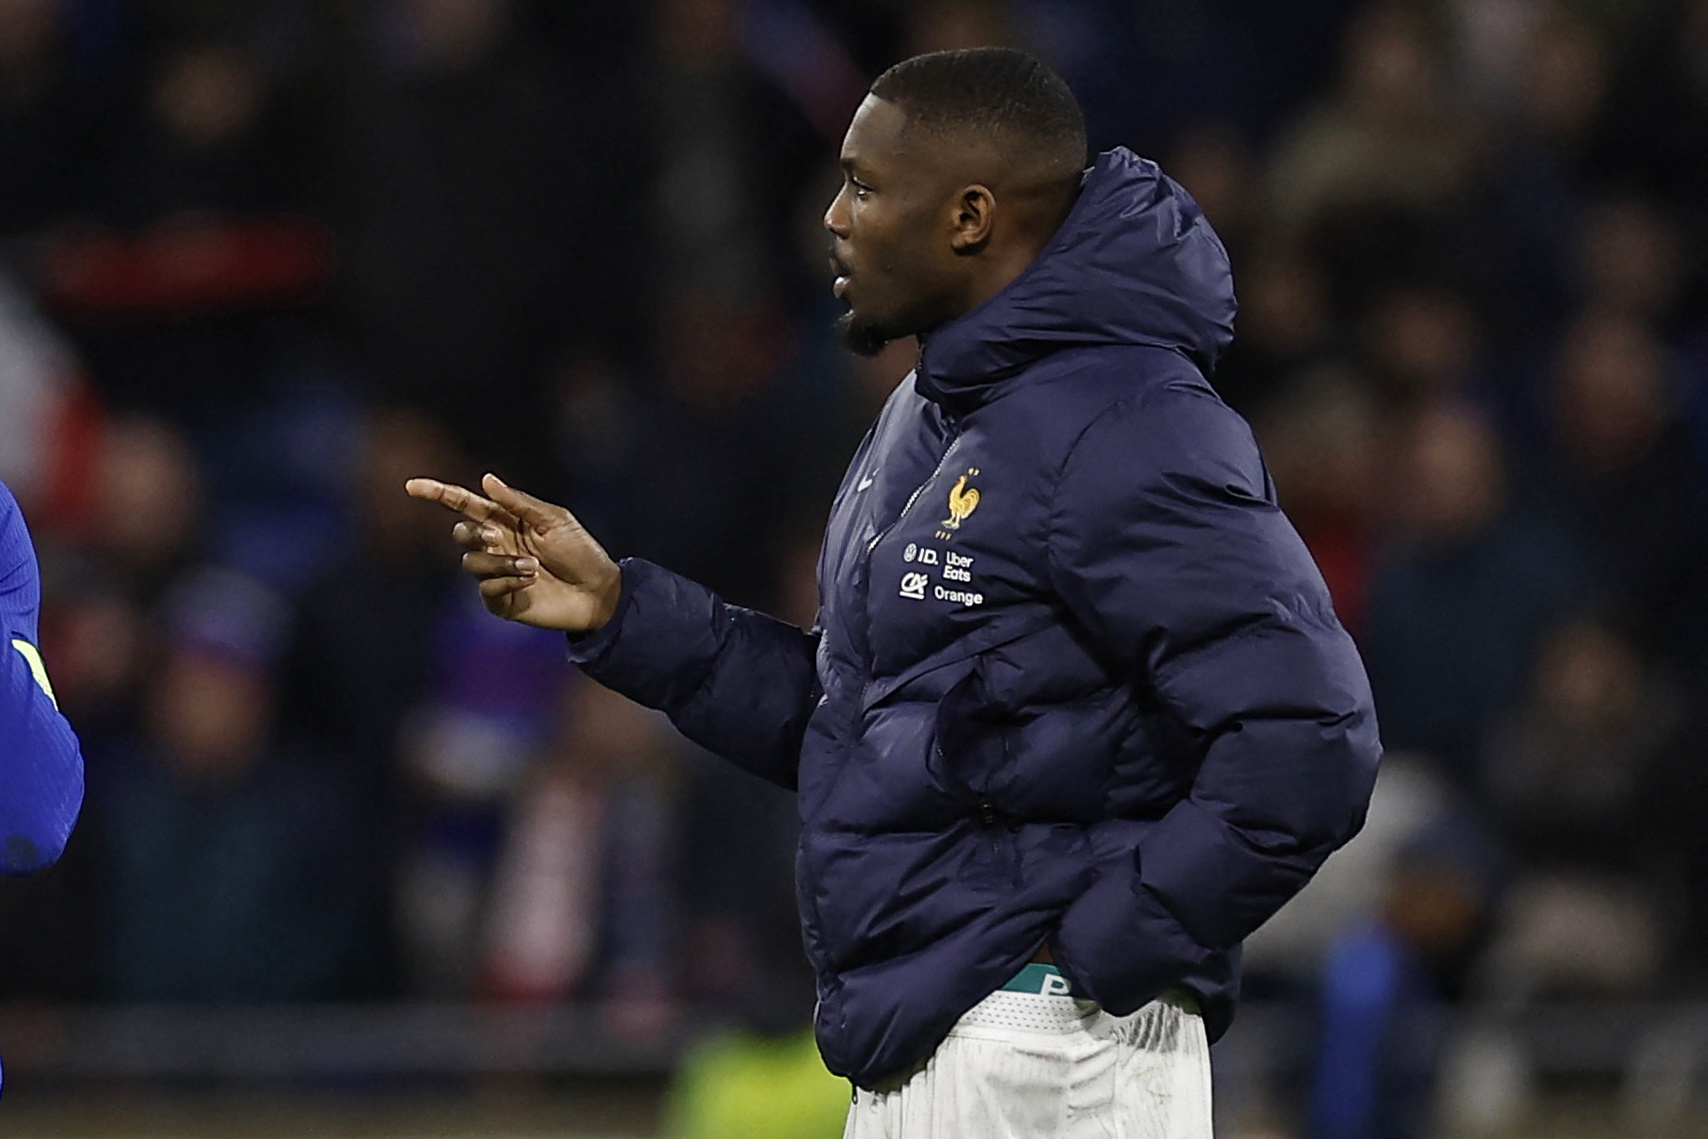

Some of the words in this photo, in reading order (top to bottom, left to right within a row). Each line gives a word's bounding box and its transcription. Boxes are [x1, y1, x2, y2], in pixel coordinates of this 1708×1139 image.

[946, 551, 974, 568] Uber
[943, 565, 971, 582] Eats
[934, 586, 983, 606] Orange
